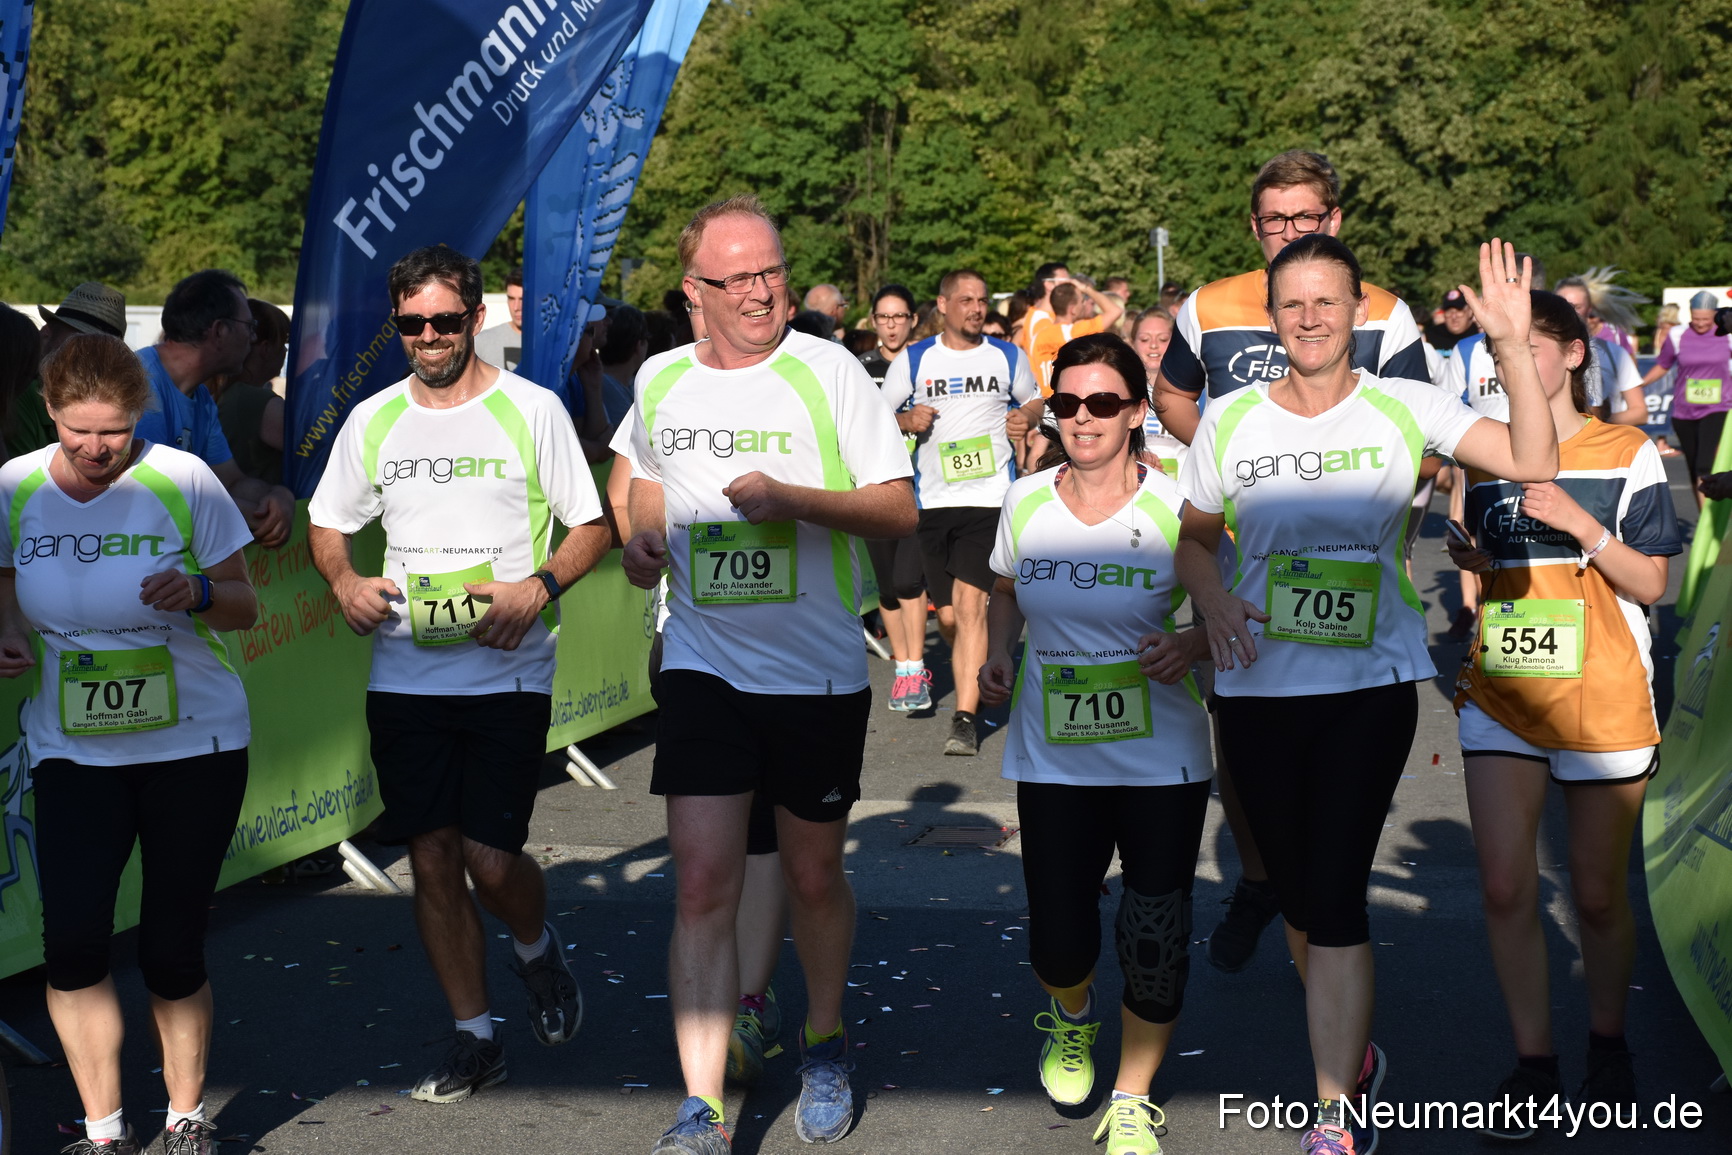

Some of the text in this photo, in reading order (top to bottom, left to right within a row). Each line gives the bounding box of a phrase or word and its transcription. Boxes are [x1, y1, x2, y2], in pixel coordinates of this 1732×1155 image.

[491, 0, 602, 126] Druck und M
[661, 428, 792, 458] gangart
[383, 456, 507, 486] gangart
[952, 451, 982, 470] 831
[1236, 446, 1385, 487] gangart
[19, 533, 165, 566] gangart
[710, 550, 771, 580] 709
[1020, 558, 1157, 590] gangart
[710, 581, 773, 590] Kolp Alexander
[424, 594, 476, 625] 711
[1292, 588, 1355, 622] 705
[426, 625, 455, 634] Hoffman
[1296, 620, 1348, 631] Kolp Sabine
[1501, 628, 1558, 655] 554
[1503, 656, 1520, 664] Klug
[81, 679, 146, 711] 707
[1064, 692, 1125, 721] 710
[86, 709, 148, 721] Hoffman Gabi
[1064, 720, 1131, 731] Steiner Susanne
